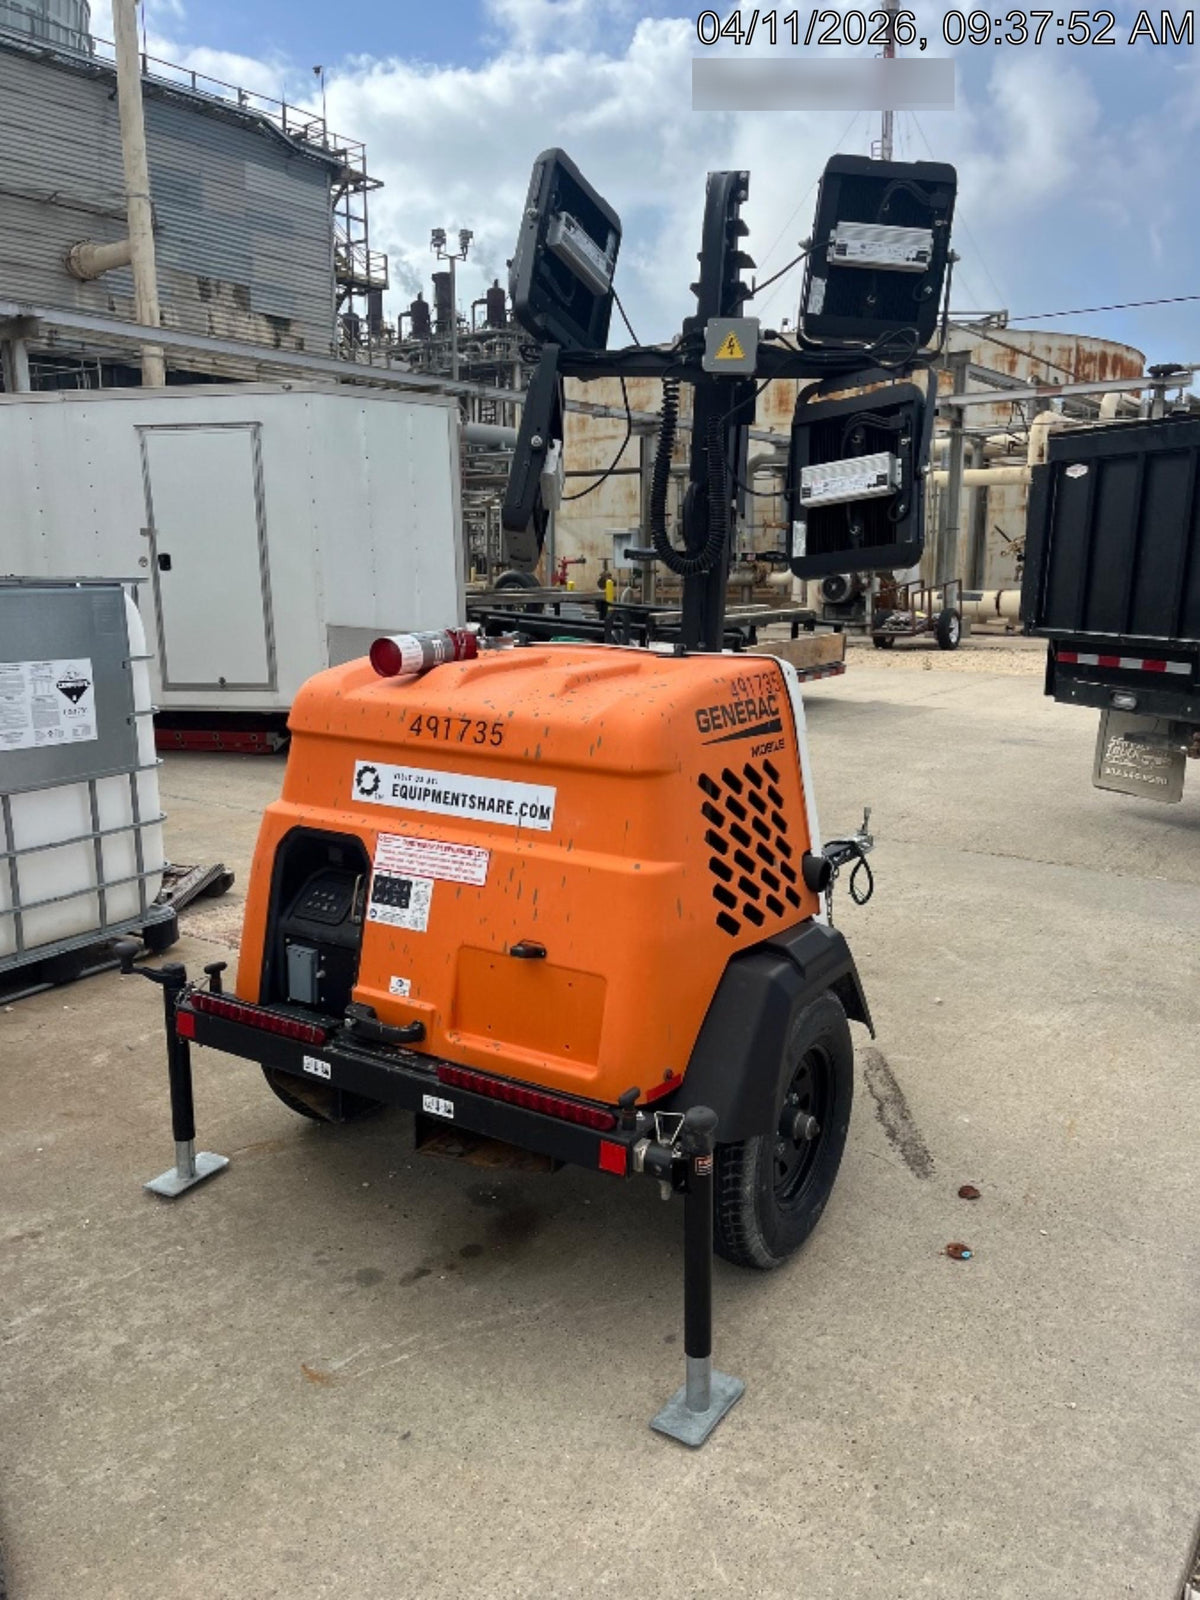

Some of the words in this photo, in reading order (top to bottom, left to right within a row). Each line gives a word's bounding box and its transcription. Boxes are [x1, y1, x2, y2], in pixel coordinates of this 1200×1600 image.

[409, 715, 504, 746] 491735
[695, 695, 779, 733] GENERAC
[391, 783, 551, 821] EQUIPMENTSHARE.COM
